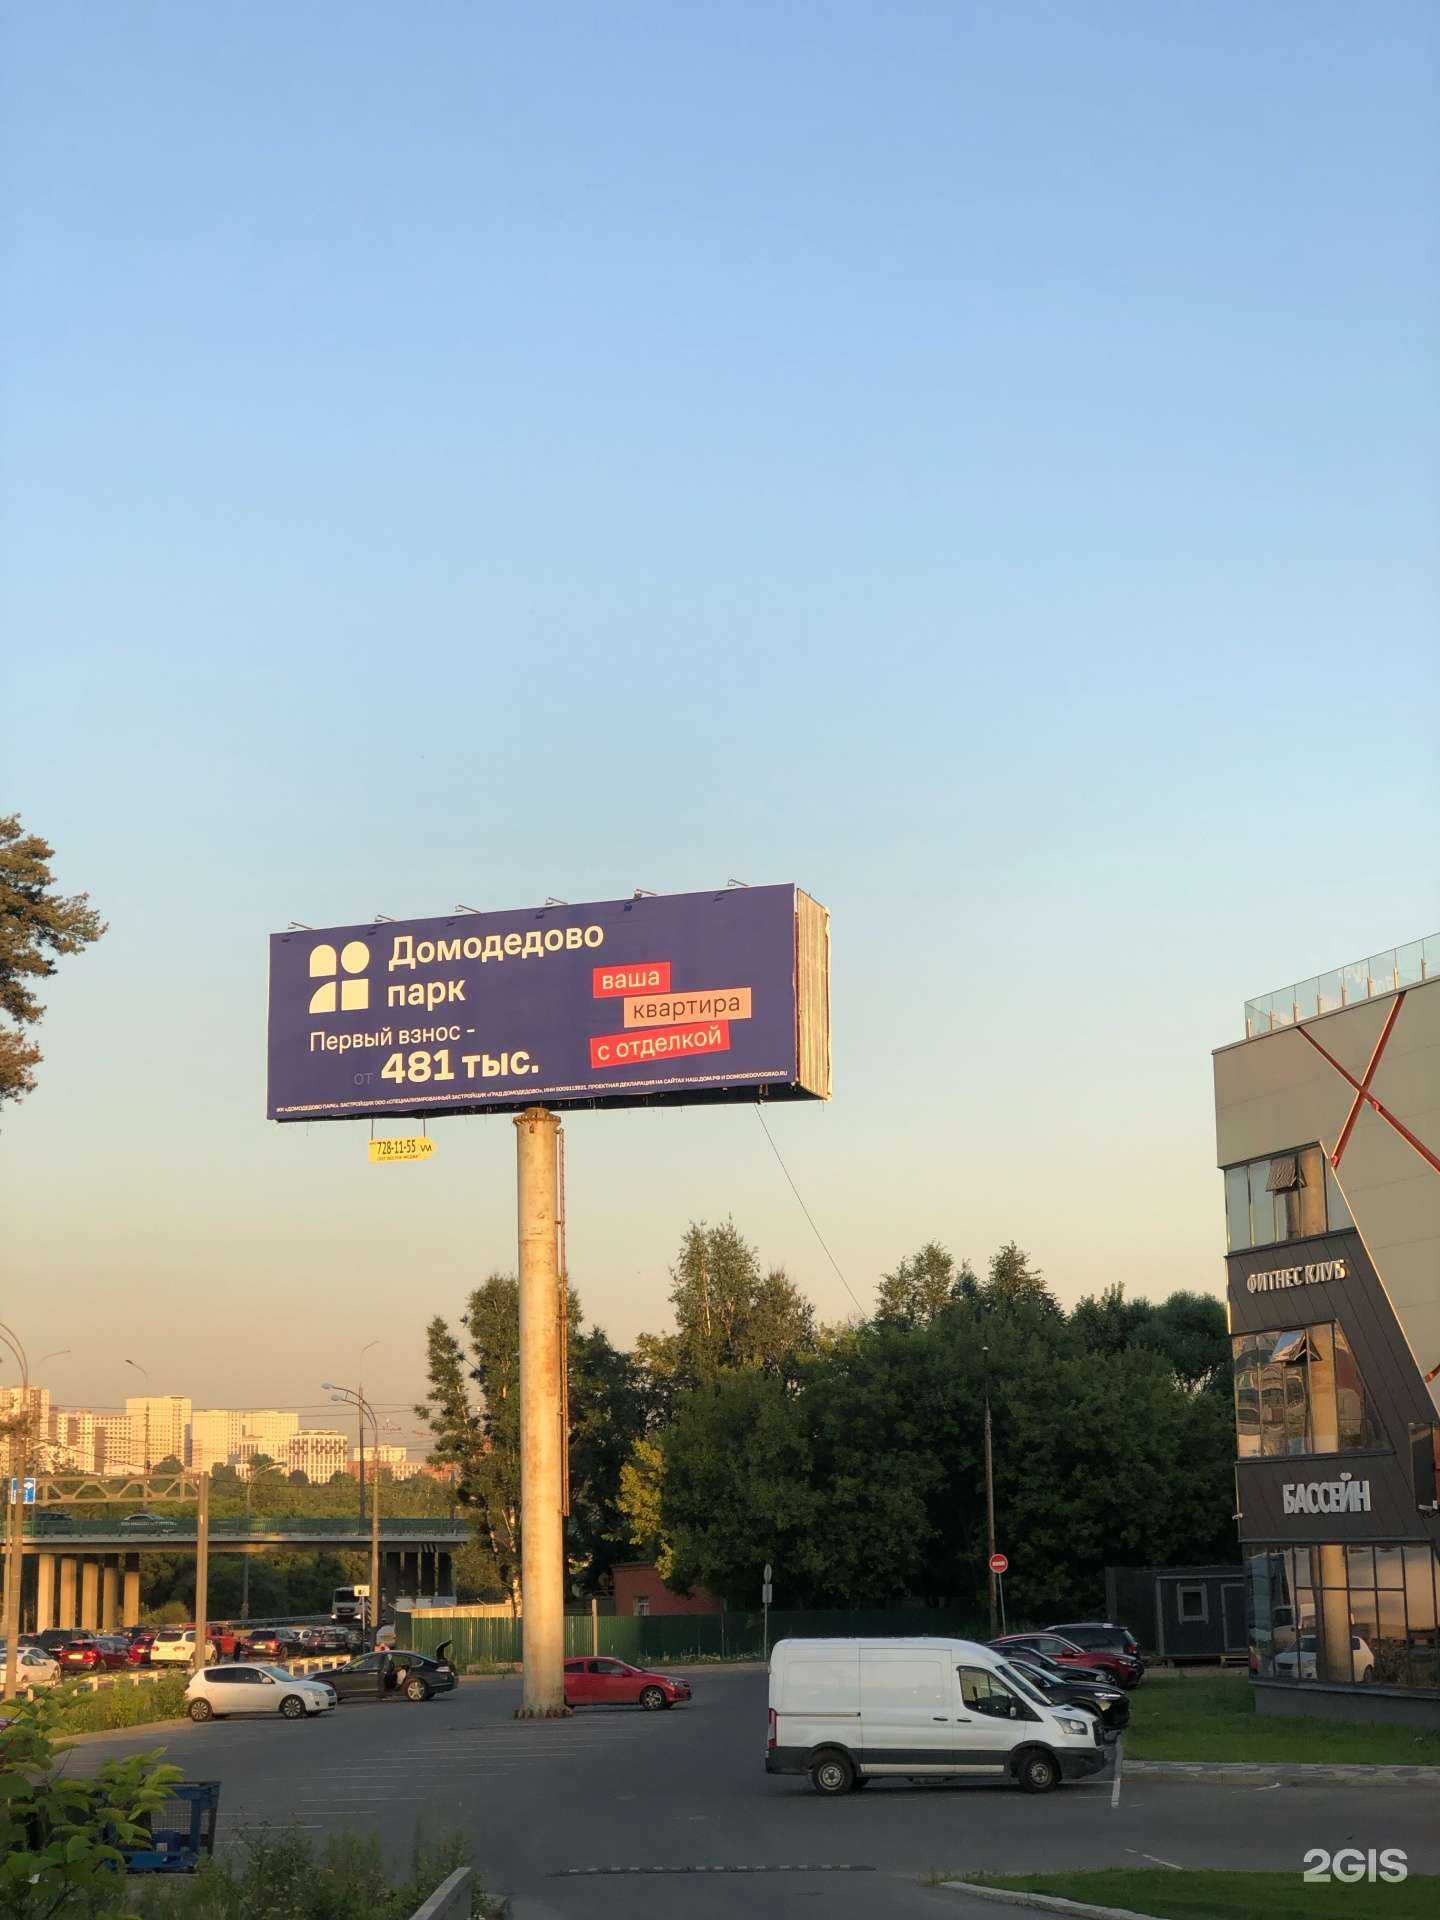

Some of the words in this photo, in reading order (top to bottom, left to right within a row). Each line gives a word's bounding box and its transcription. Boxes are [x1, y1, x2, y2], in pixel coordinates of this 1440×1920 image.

[388, 925, 604, 971] Домодедово
[387, 979, 466, 1012] парк
[602, 969, 660, 990] ваша
[633, 994, 740, 1021] квартира
[310, 1026, 392, 1054] Первый
[399, 1024, 460, 1044] взнос
[597, 1043, 610, 1061] с
[616, 1025, 721, 1058] отделкой
[353, 1072, 374, 1086] от
[381, 1048, 455, 1084] 481
[462, 1050, 539, 1079] тыс.
[377, 1140, 416, 1155] 728-11-55
[1246, 1265, 1303, 1294] ФИТНЕС
[1304, 1259, 1346, 1285] КЛУБ
[1283, 1472, 1372, 1515] БАССЕЙН
